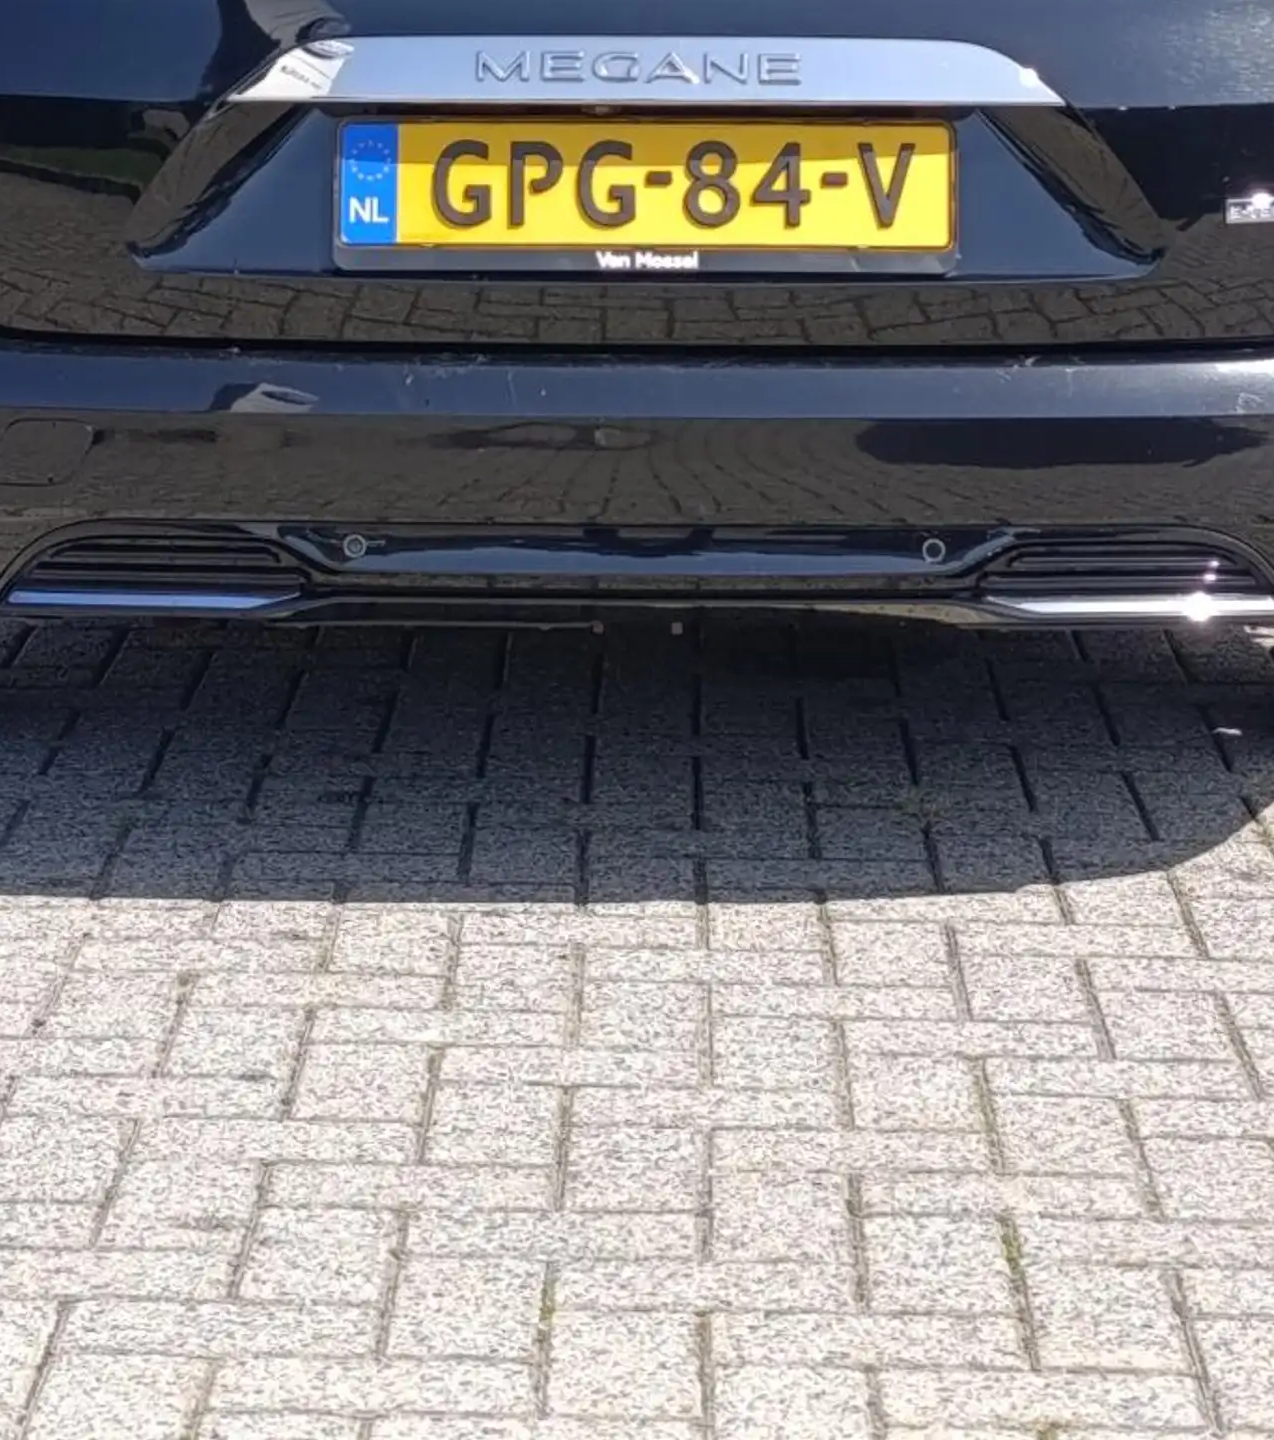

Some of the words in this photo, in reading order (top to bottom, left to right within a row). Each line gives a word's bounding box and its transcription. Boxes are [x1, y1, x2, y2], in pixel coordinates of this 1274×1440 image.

[474, 49, 802, 87] MEGANE
[432, 140, 917, 229] GPG-84-V
[348, 194, 389, 225] NL
[595, 249, 632, 269] Van
[634, 249, 700, 270] Mossel
